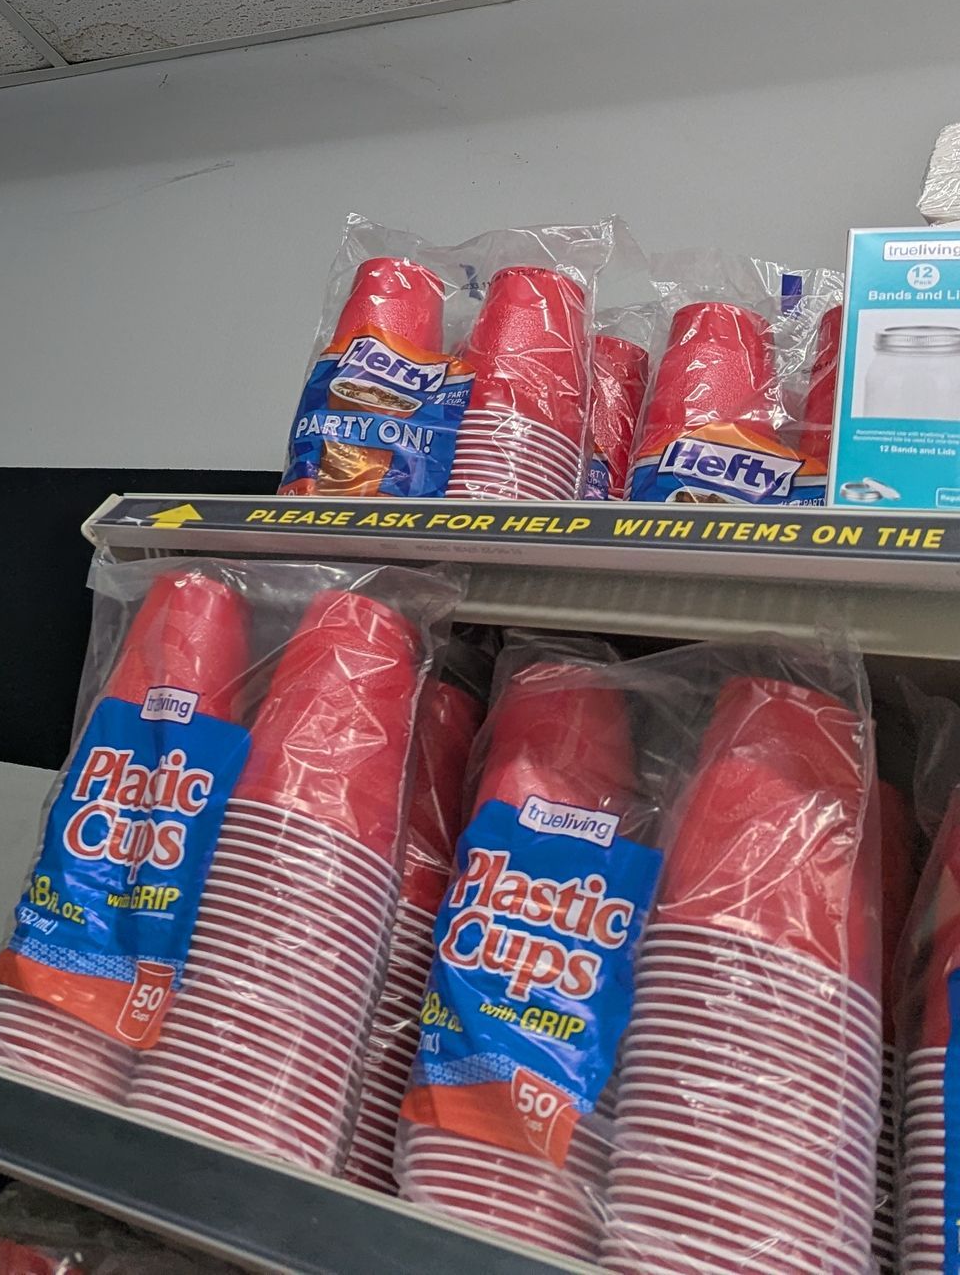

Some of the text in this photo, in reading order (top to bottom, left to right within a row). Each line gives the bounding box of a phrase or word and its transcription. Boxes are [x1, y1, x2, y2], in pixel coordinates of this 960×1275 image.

[888, 243, 960, 258] trueliving
[911, 266, 934, 279] 12
[868, 290, 960, 301] Bands and Li
[345, 340, 443, 392] Hefty
[447, 389, 470, 399] PARTY
[295, 414, 434, 453] PARTY ON!
[880, 445, 956, 456] 12 Bands and Lids
[665, 441, 790, 495] Hefty
[246, 509, 945, 550] PLEASE ASK FOR HELP WITH ITEMS ON THE
[528, 803, 612, 839] trueliving
[64, 802, 186, 884] Cups
[62, 902, 86, 925] oz.
[131, 886, 181, 910] GRIP
[450, 849, 633, 948] Plastic
[440, 907, 602, 1001] Cups
[131, 1009, 150, 1022] Cups
[132, 984, 164, 1011] 50
[480, 1002, 586, 1040] with GRIP
[518, 1082, 558, 1118] 50
